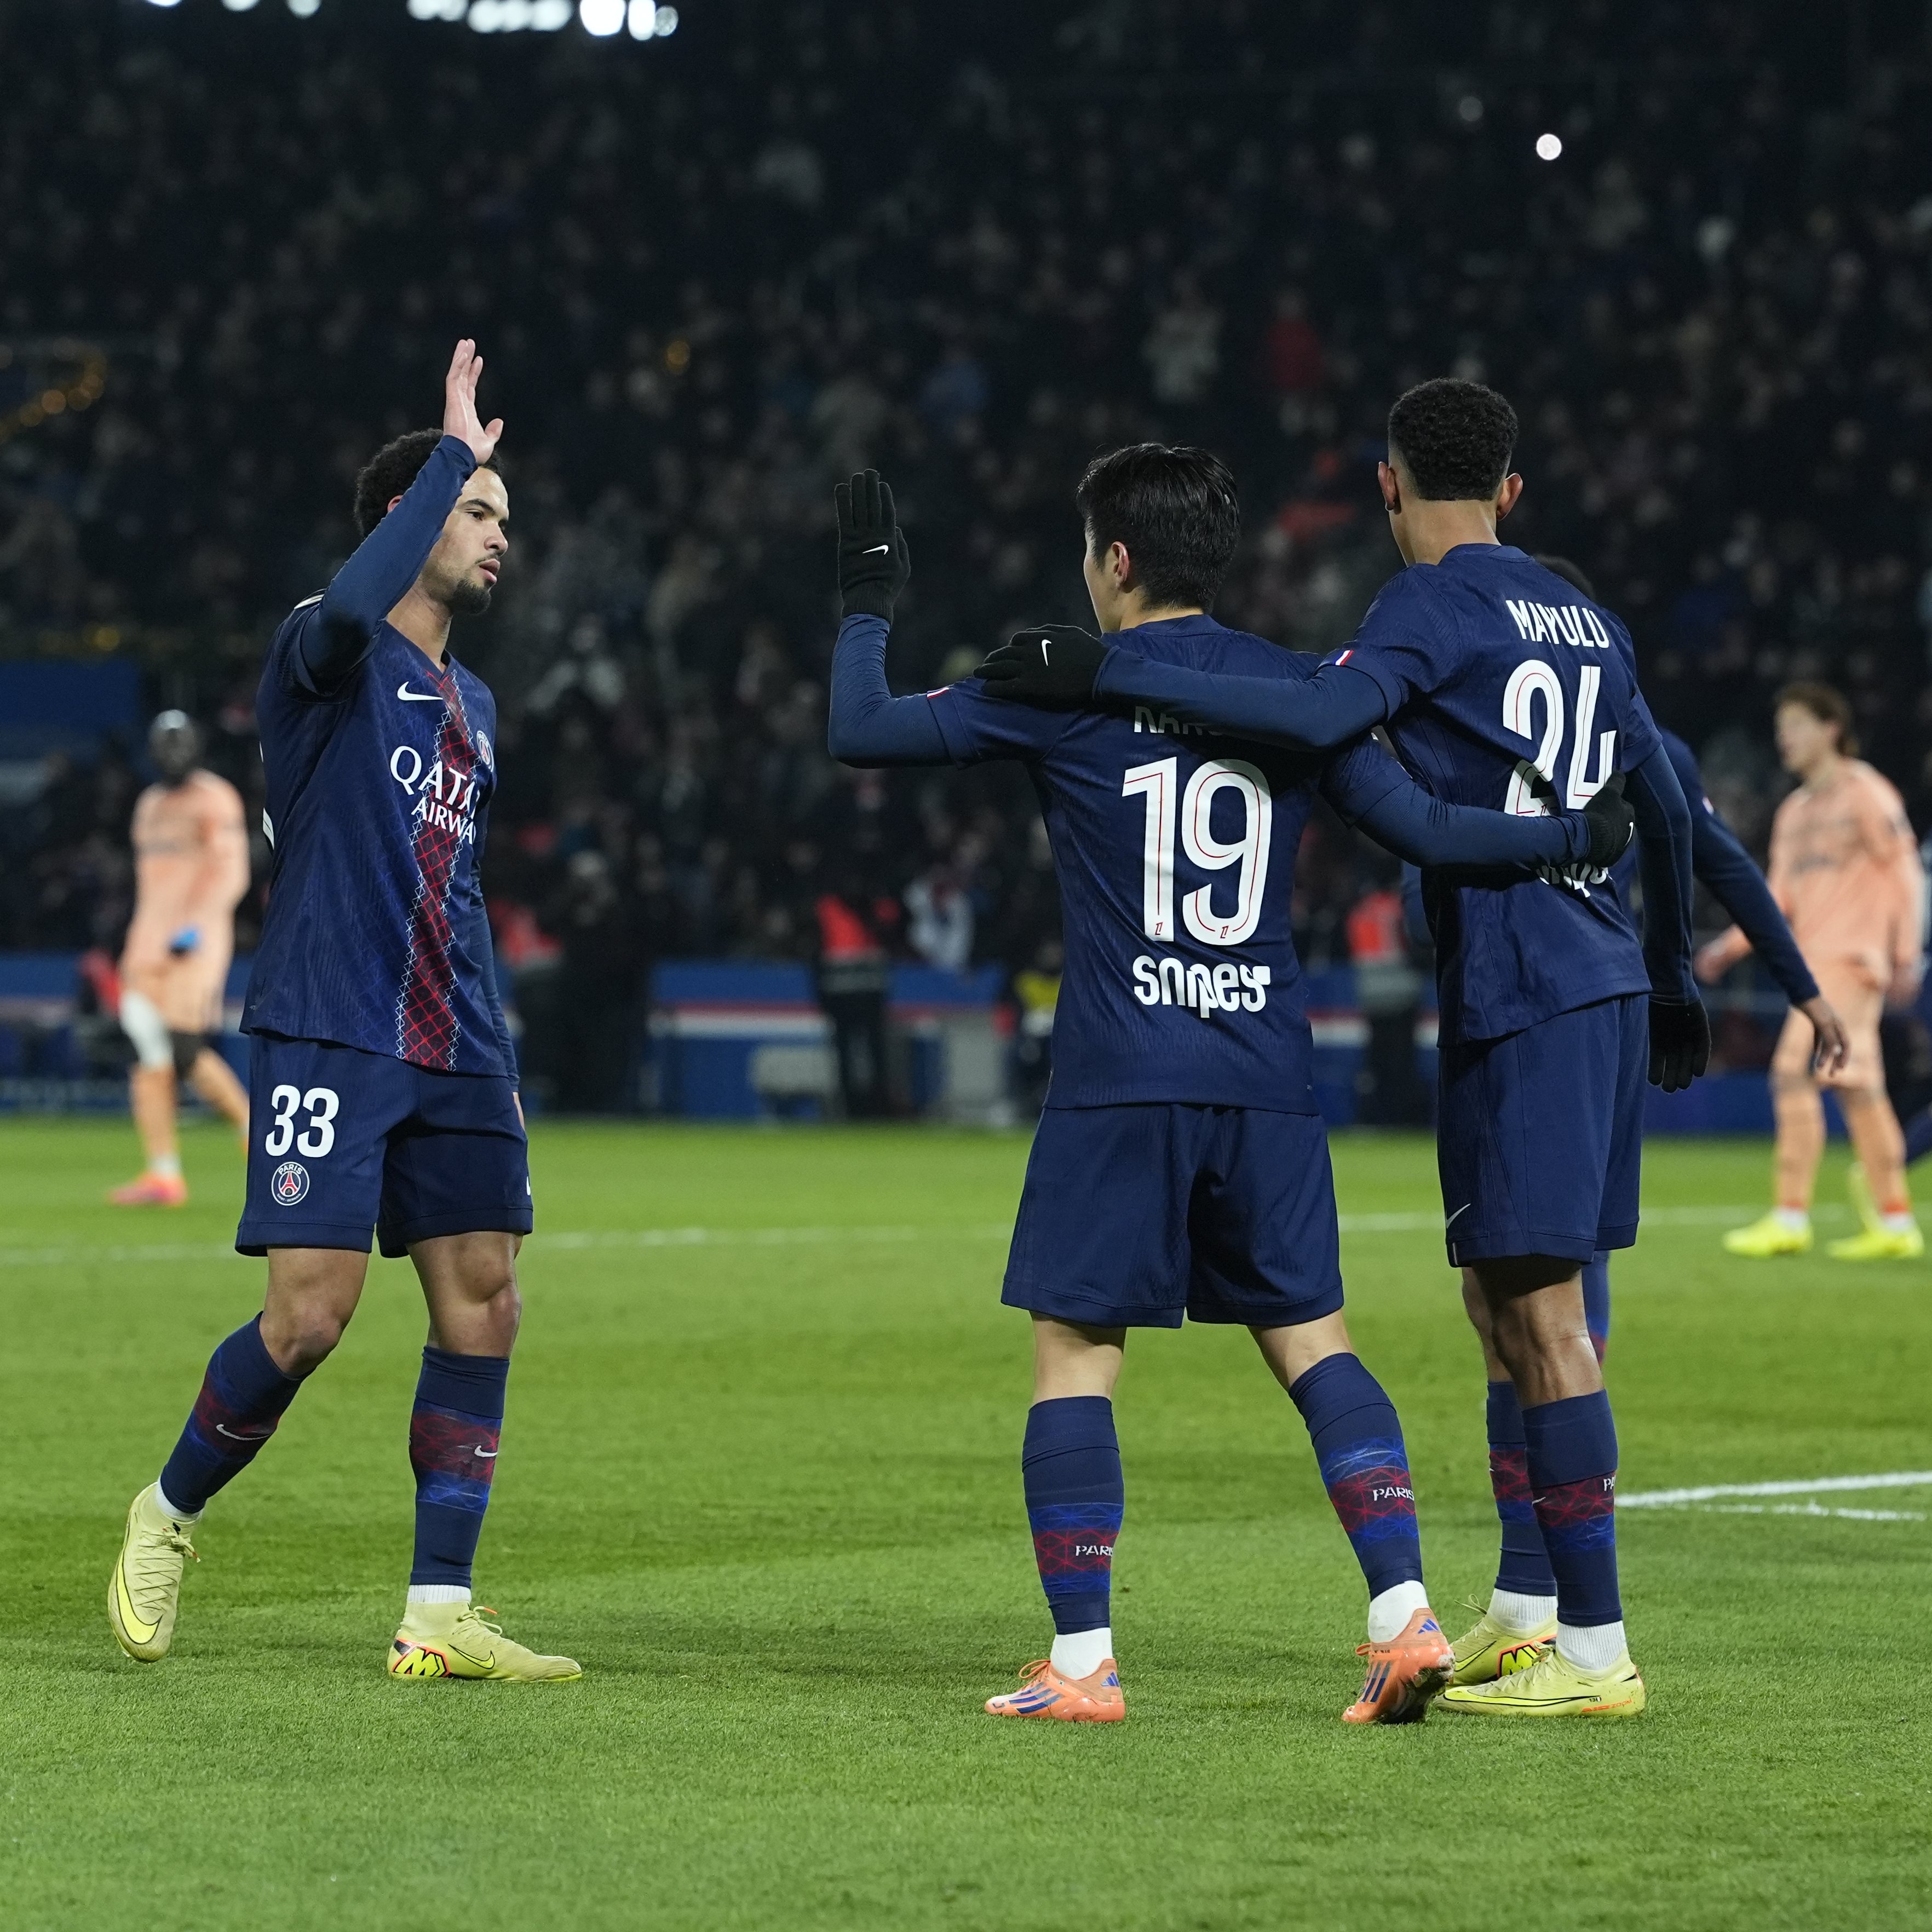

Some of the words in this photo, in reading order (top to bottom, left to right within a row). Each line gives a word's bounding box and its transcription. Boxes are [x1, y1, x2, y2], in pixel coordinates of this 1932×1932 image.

[1505, 600, 1609, 648] MAYULU
[1503, 659, 1617, 817] 24
[411, 797, 476, 845] AIRWA
[1122, 756, 1272, 946] 19
[265, 1084, 339, 1158] 33
[278, 1164, 303, 1175] PARIS
[1373, 1487, 1415, 1501] PARIS
